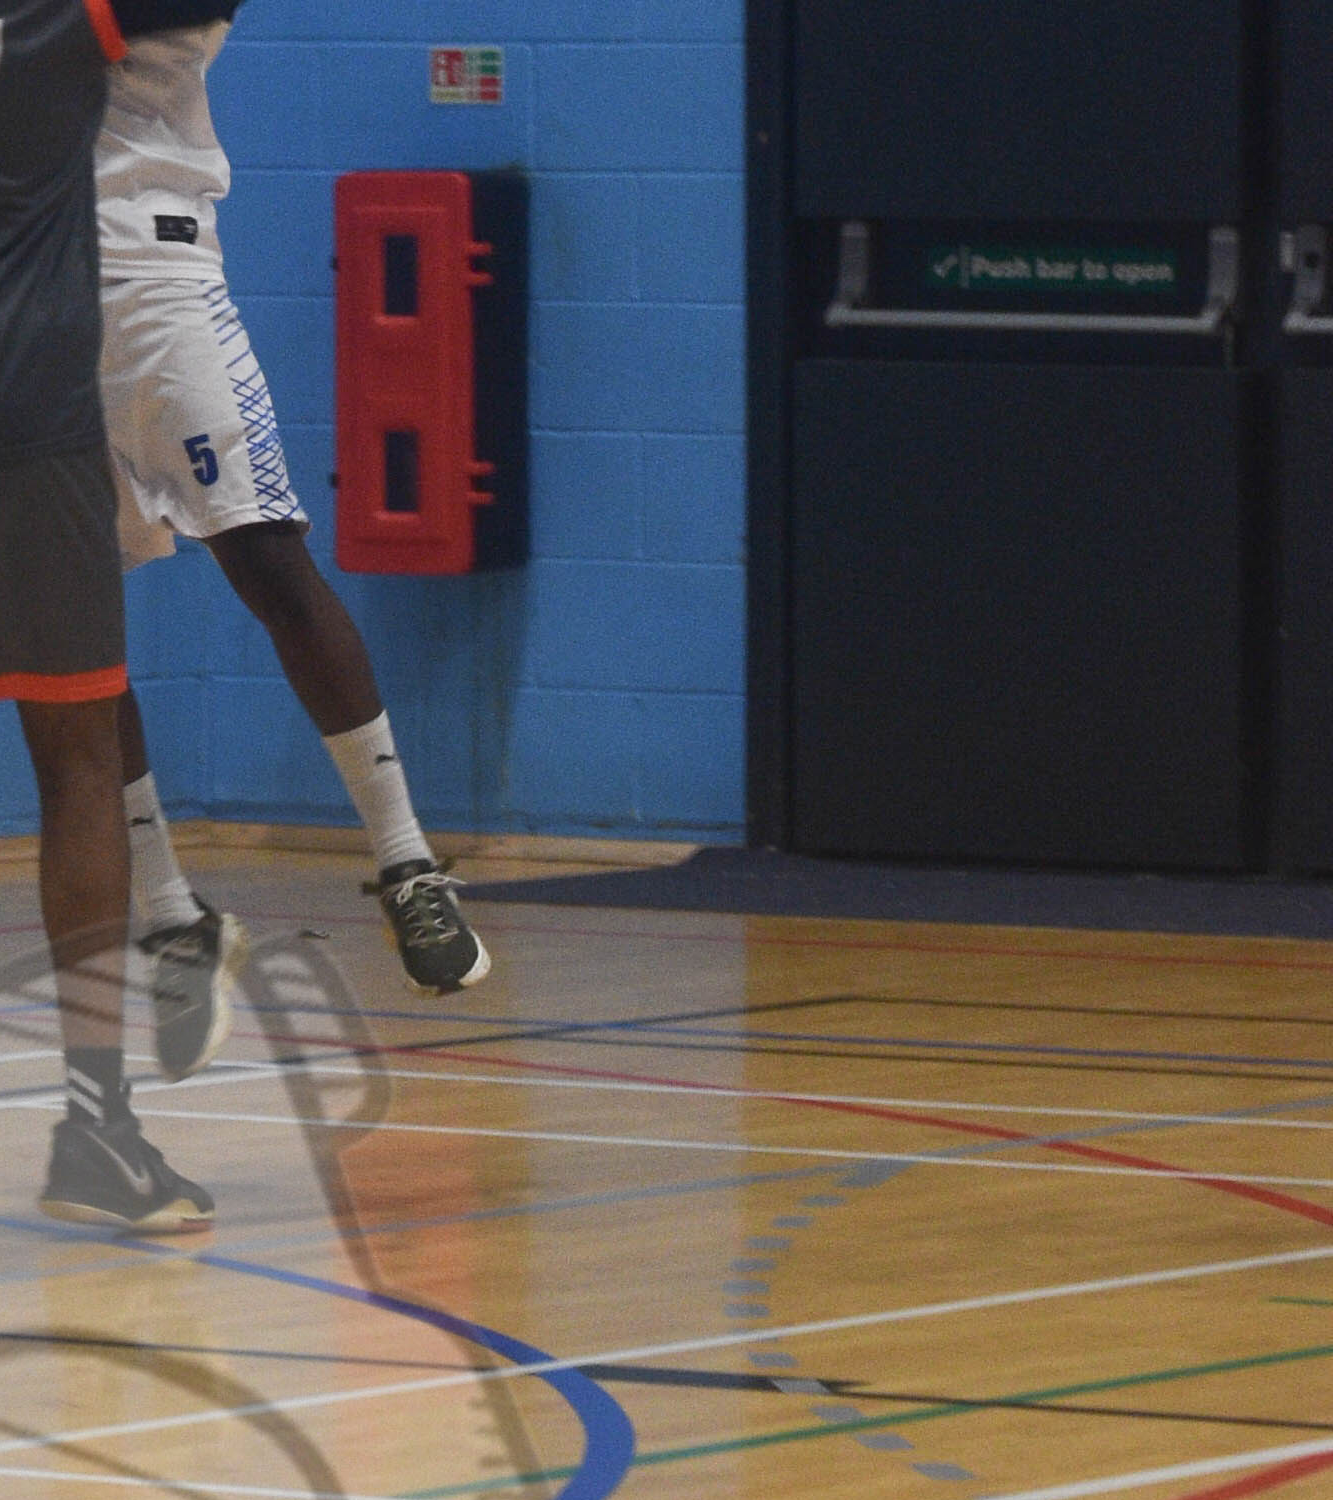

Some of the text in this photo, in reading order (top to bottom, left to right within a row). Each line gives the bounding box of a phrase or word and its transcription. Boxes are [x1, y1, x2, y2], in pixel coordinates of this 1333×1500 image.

[971, 254, 1174, 286] Push bar to open
[183, 433, 220, 487] 5
